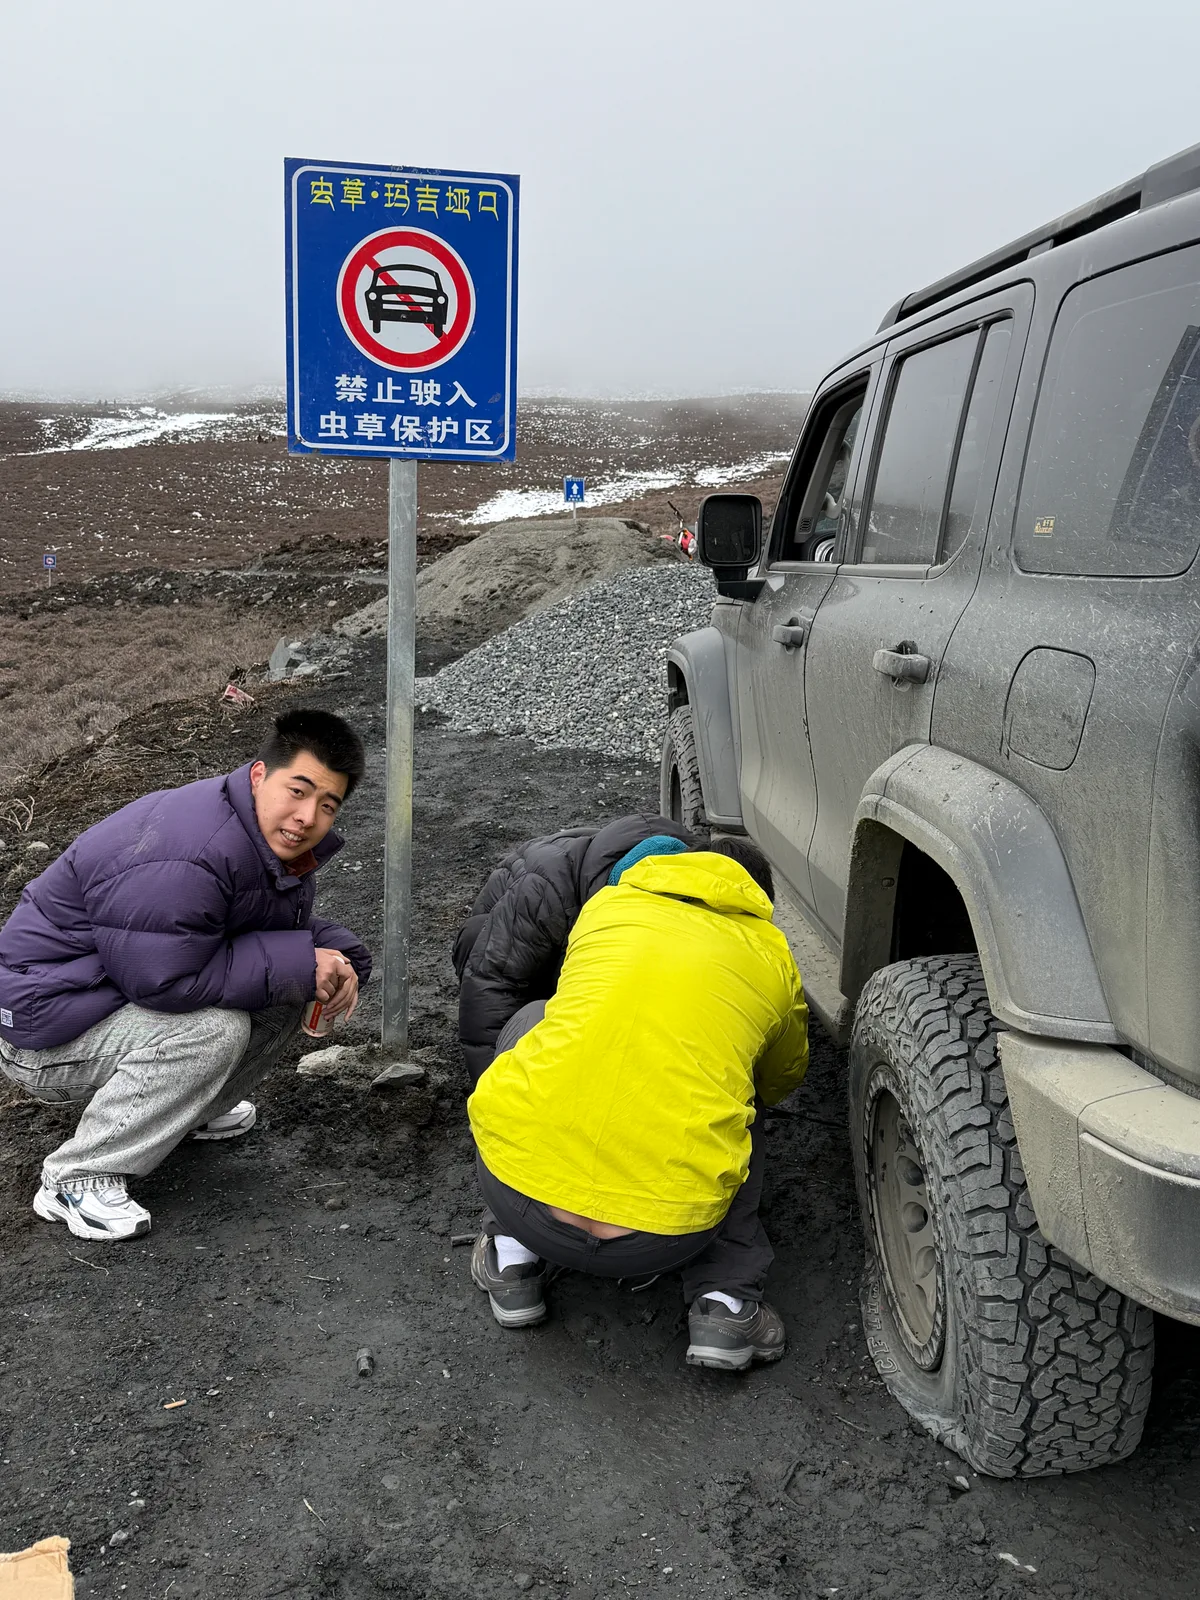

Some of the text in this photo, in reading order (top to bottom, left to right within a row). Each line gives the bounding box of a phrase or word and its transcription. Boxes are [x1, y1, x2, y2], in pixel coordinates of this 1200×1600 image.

[335, 374, 477, 408] 禁止驶入
[318, 411, 494, 445] 虫草保护区
